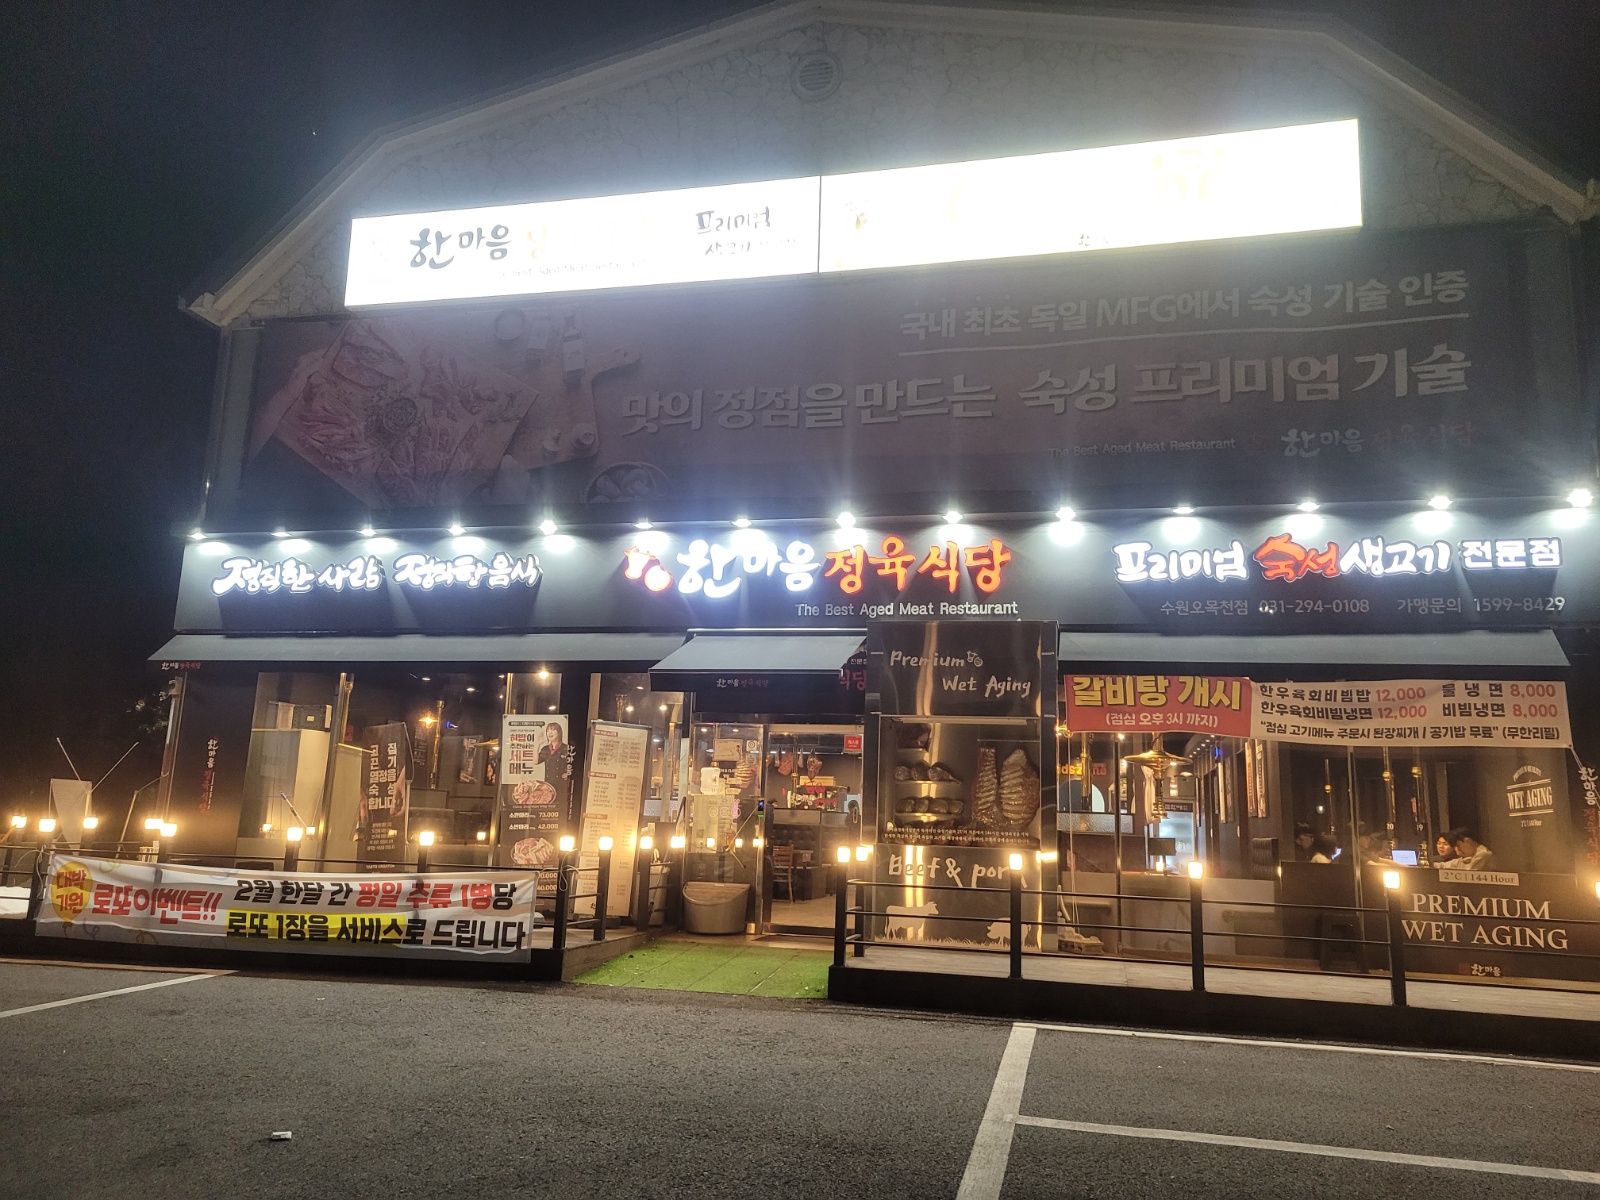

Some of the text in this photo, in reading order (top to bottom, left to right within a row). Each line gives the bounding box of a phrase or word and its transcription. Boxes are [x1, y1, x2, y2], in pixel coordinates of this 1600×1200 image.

[409, 223, 513, 270] 한마음
[899, 270, 1469, 340] 국내 최초 독일 MFG에서 숙성 기술 인증
[620, 344, 1471, 437] 맛의 정점을 만드는 숙성 프리미엄 기술
[1048, 438, 1237, 459] The Best Aged Meat Restaurant
[824, 536, 1012, 594] 정육식당
[1114, 540, 1249, 582] 프리미엄
[1460, 538, 1562, 569] 전문점
[211, 553, 541, 594] 정직한 사람 정직한 음식
[797, 602, 1019, 619] The Best Aged Meat Restaurant
[1160, 596, 1566, 616] 수원오목천점 031-294-0108 가맹문의 1599-8429
[890, 650, 965, 667] Premium
[943, 675, 1031, 699] Wet Aging
[1073, 675, 1242, 711] 갈비탕 개시
[1259, 684, 1371, 703] 한우육회비빔밥
[1376, 687, 1426, 702] 12,000
[1510, 684, 1556, 698] 8,000
[1106, 713, 1218, 727] (점심 오후 3시 까지)
[1261, 701, 1558, 720] 한우육회비빔냉면 12,000 비빔냉면 8,000
[1289, 725, 1334, 738] 고기메뉴
[1337, 728, 1370, 739] 주문시
[1373, 726, 1419, 739] 된장찌개
[1430, 726, 1466, 739] 공기밥
[1502, 726, 1560, 740] (무한리필)
[509, 750, 533, 762] 세트
[509, 763, 534, 774] 메뉴
[1507, 786, 1553, 810] WET AGING
[888, 854, 940, 879] Beef
[1471, 873, 1488, 882] 144
[1490, 874, 1516, 884] Hour
[56, 869, 87, 890] 대박
[56, 891, 84, 914] 기원
[92, 883, 223, 924] 로또이벤트!!
[234, 880, 517, 911] 2월 한달 간 평일 주류 1병당
[1411, 893, 1551, 919] PREMIUM
[226, 912, 526, 949] 로또 1장을 서비스로 드립니다
[1401, 919, 1568, 950] WET AGING
[1470, 963, 1502, 977] 한마음
